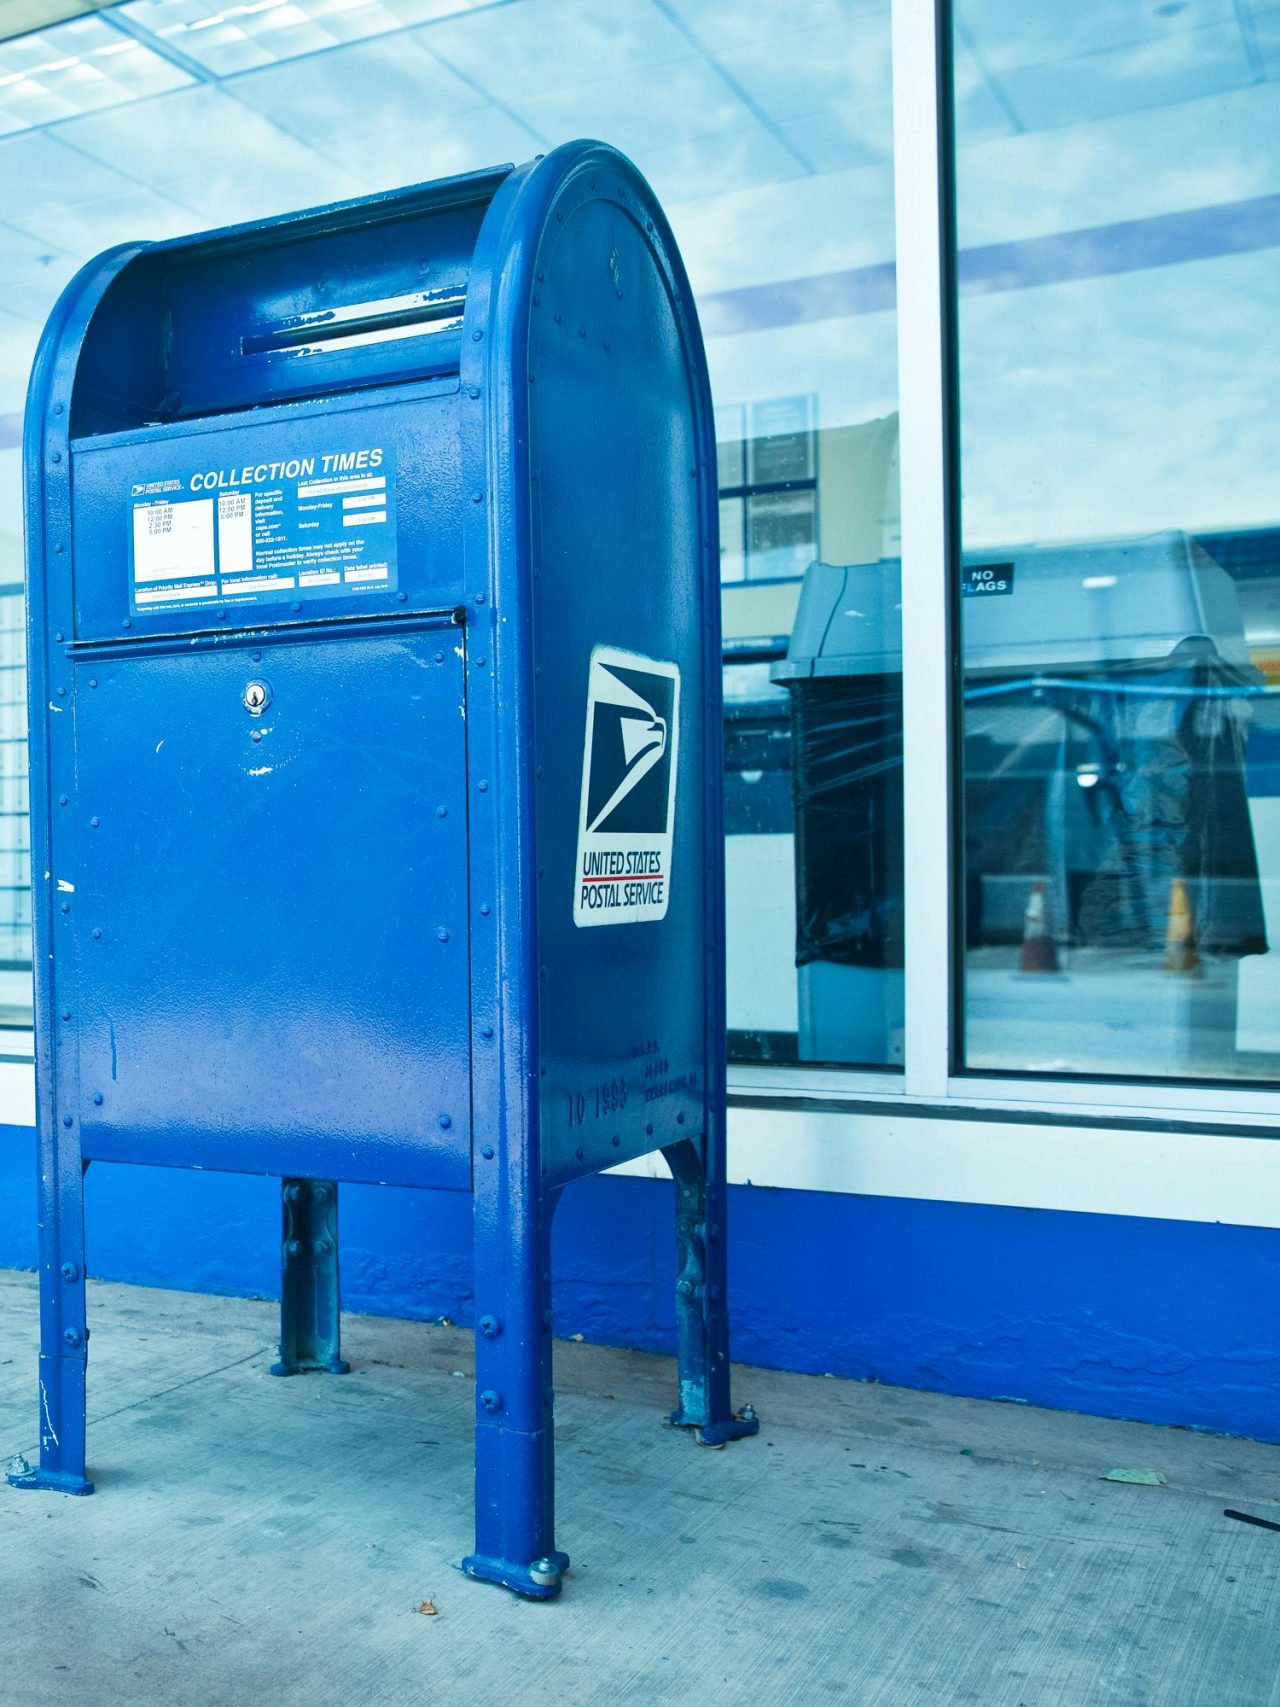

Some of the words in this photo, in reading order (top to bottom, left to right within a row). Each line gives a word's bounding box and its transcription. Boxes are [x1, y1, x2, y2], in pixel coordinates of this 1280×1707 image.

[190, 458, 314, 492] COLLECTION
[321, 448, 384, 474] TIMES
[309, 476, 332, 485] Collection
[972, 570, 994, 581] NO
[583, 852, 624, 876] UNITED
[626, 851, 661, 874] STATES
[581, 884, 621, 910] POSTAL
[623, 882, 664, 906] SERVICE
